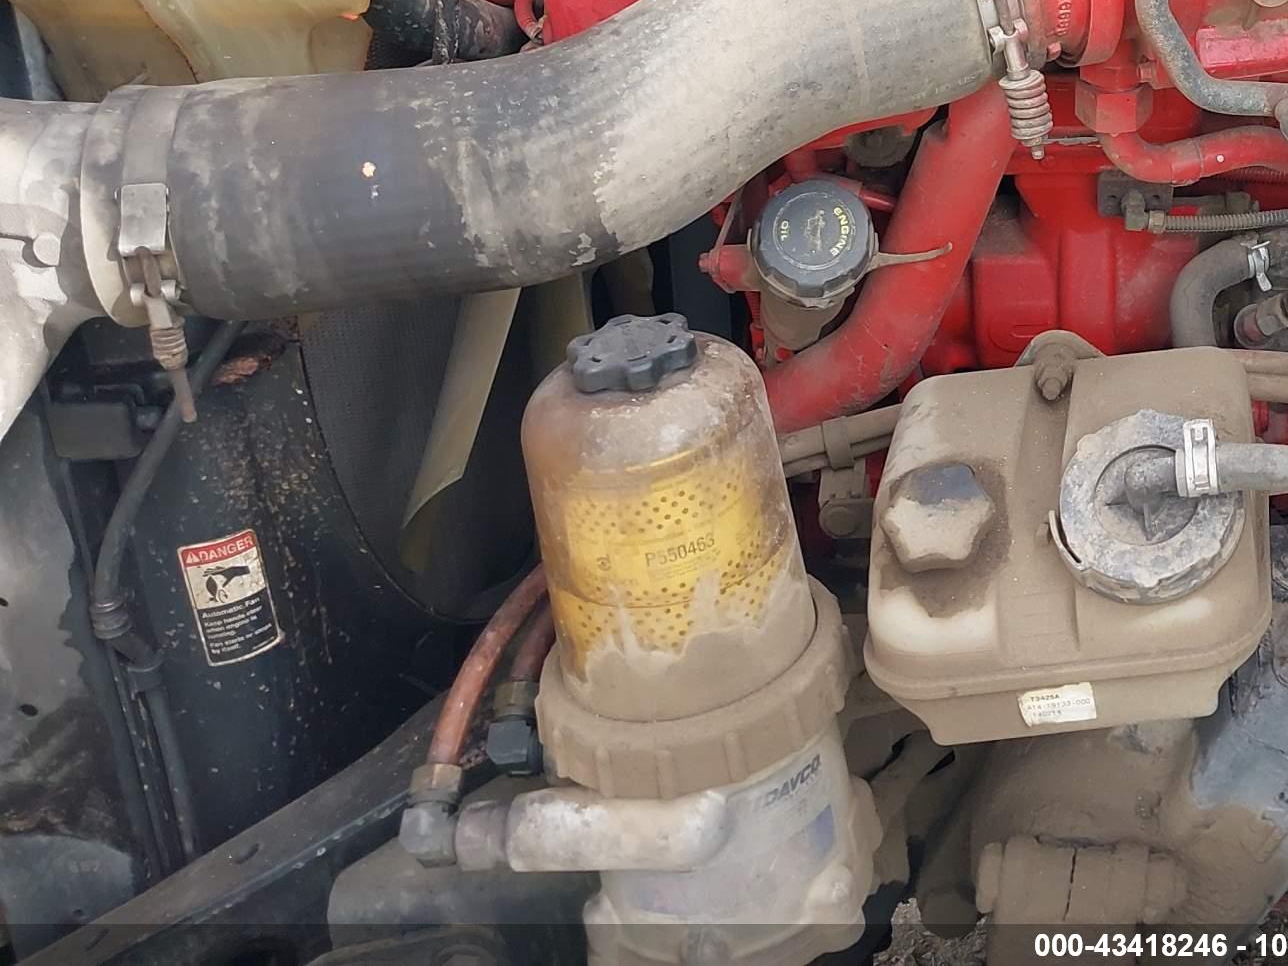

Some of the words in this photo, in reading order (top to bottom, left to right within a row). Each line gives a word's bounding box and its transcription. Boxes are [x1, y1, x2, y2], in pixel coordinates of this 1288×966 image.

[780, 221, 789, 241] OIL
[829, 207, 850, 256] ENGINE
[199, 536, 254, 561] DANGER
[644, 532, 715, 567] P550463
[202, 604, 243, 618] Automatic
[245, 597, 260, 607] Fan
[764, 754, 821, 806] DAVCO
